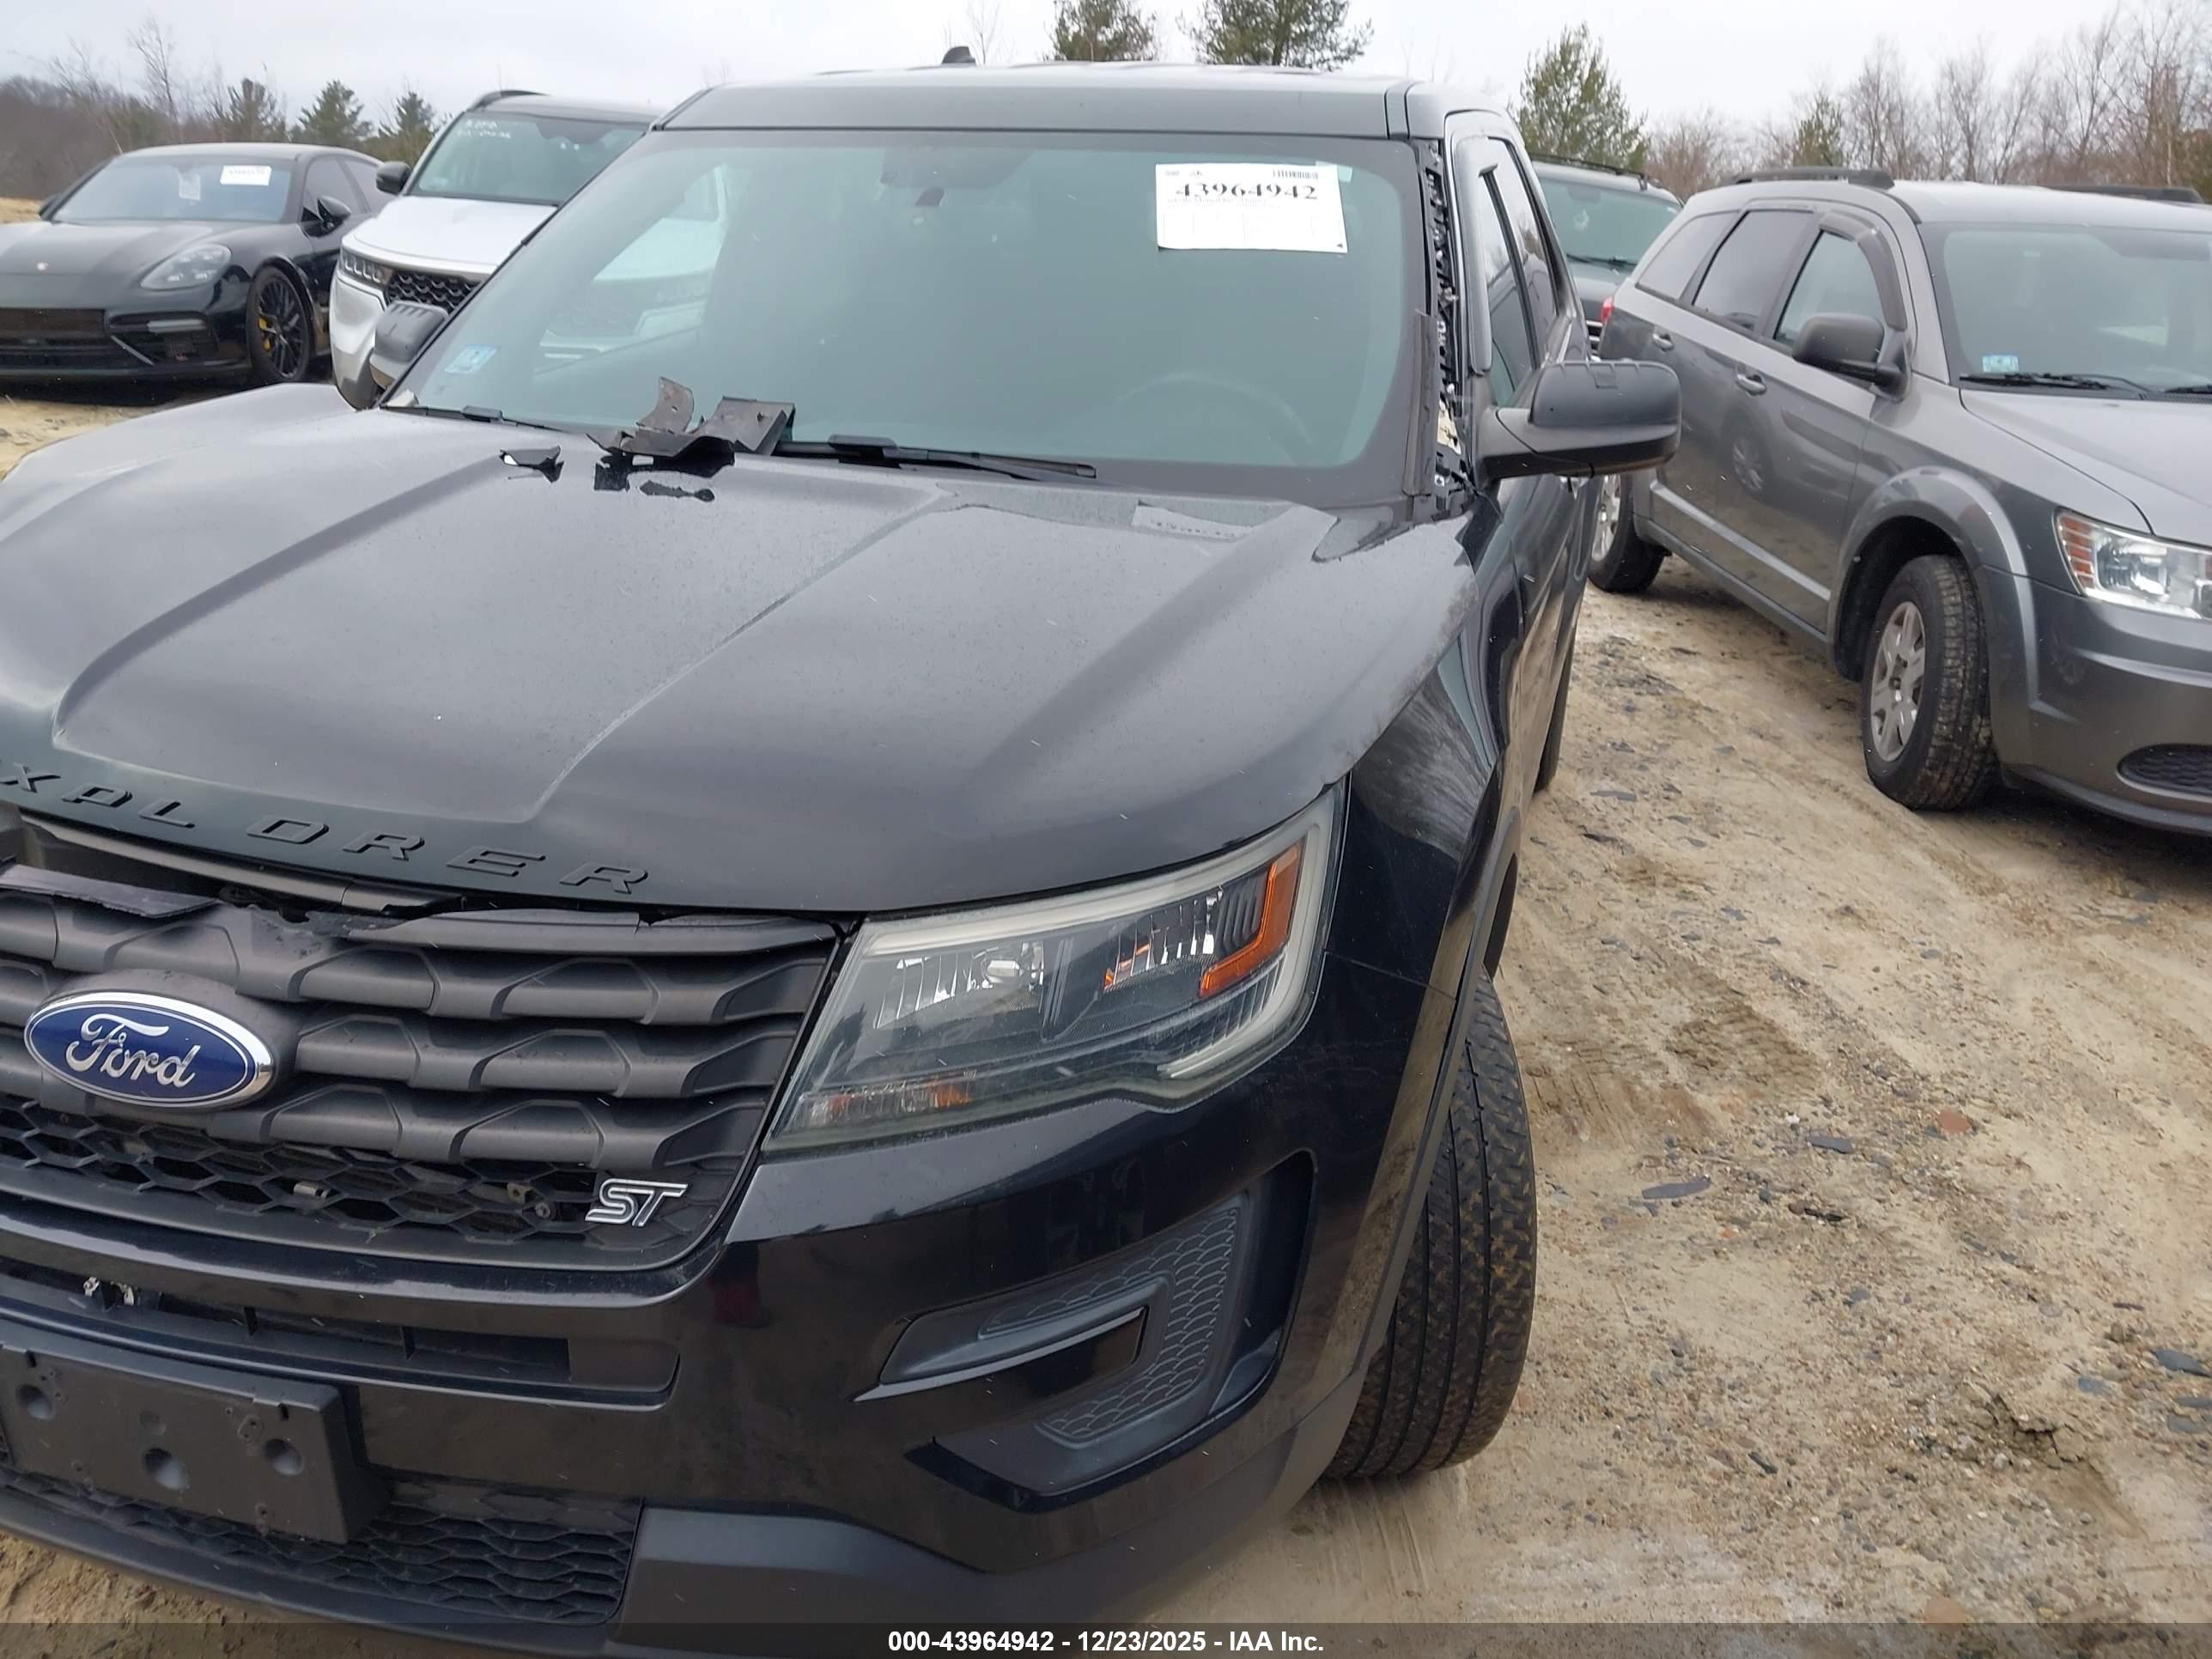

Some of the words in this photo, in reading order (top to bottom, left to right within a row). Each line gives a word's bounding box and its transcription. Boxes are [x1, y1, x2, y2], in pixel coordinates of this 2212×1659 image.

[1176, 183, 1318, 200] 43964942
[0, 759, 649, 895] XPLORER
[65, 1013, 201, 1088] Ford
[585, 1178, 689, 1227] ST
